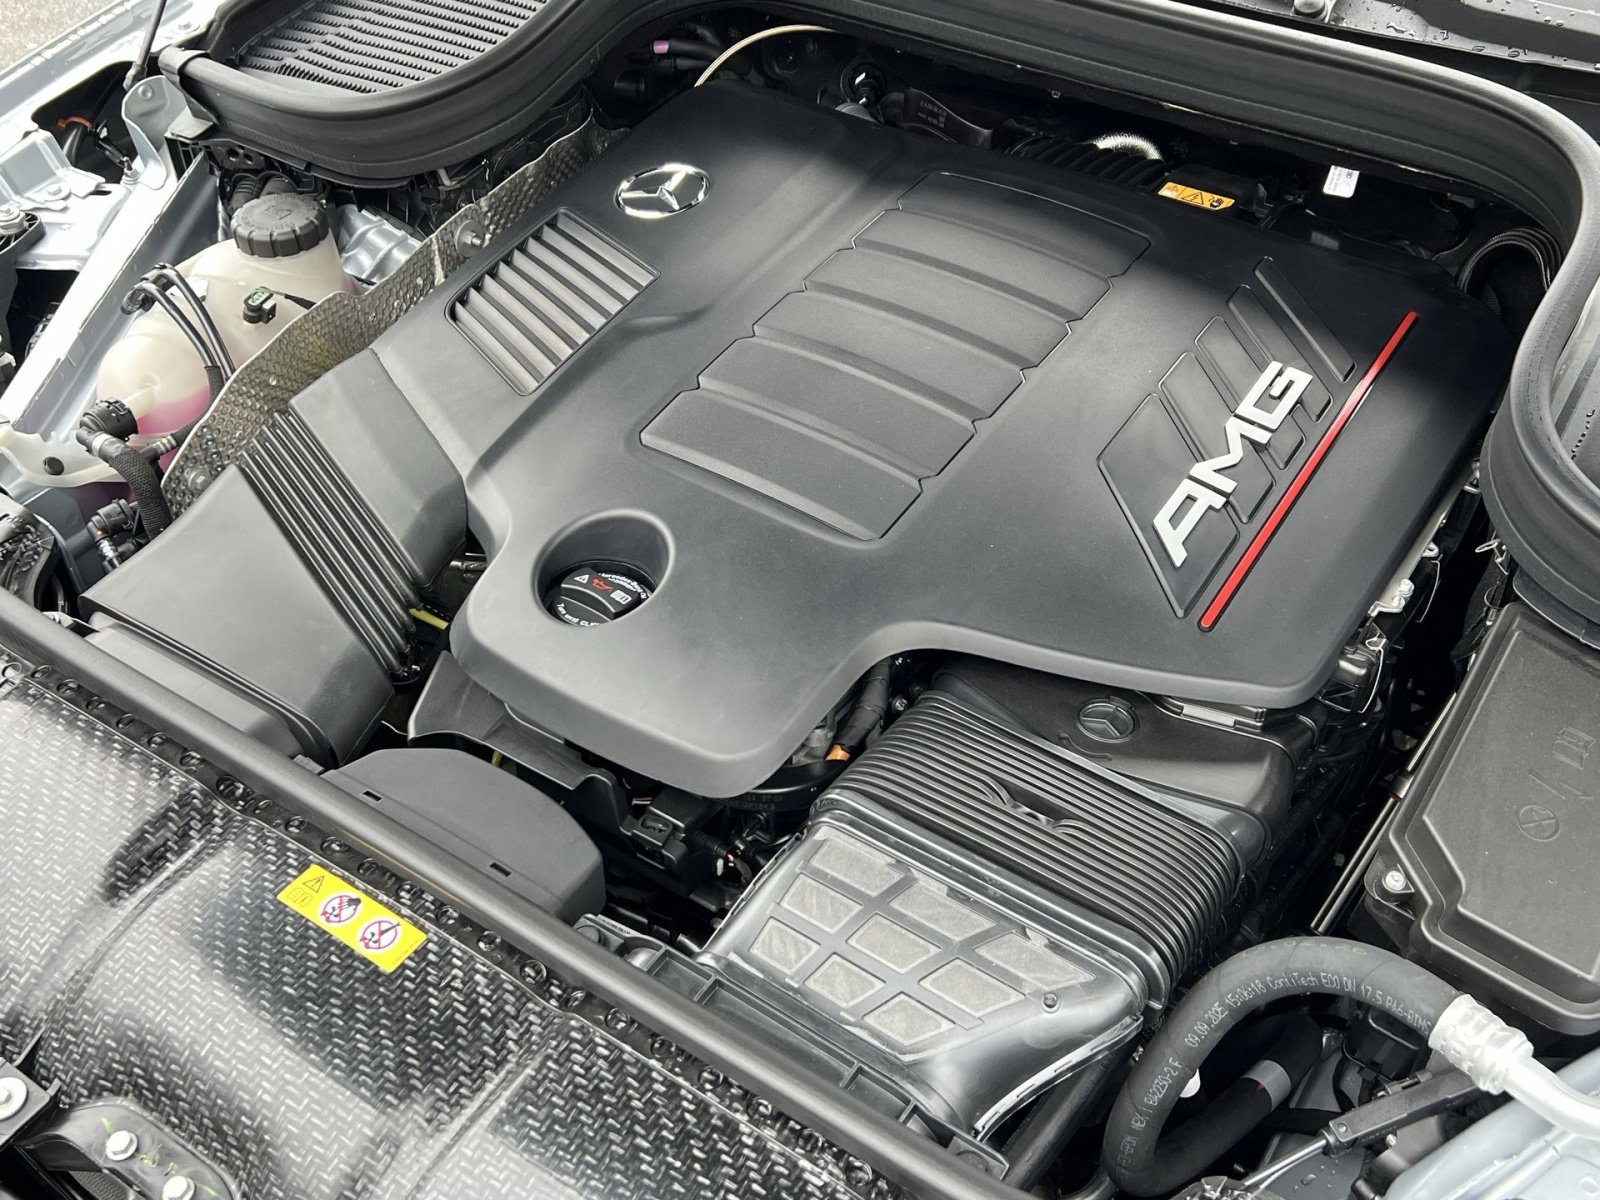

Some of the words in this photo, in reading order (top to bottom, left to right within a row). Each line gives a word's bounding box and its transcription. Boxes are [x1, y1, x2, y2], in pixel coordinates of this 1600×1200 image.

[1153, 360, 1313, 568] AMG
[1185, 1001, 1229, 1047] 09.09.2025
[1225, 979, 1267, 1008] 15:06:18
[1266, 972, 1319, 991] ContiTech
[1361, 983, 1383, 1005] 17.5
